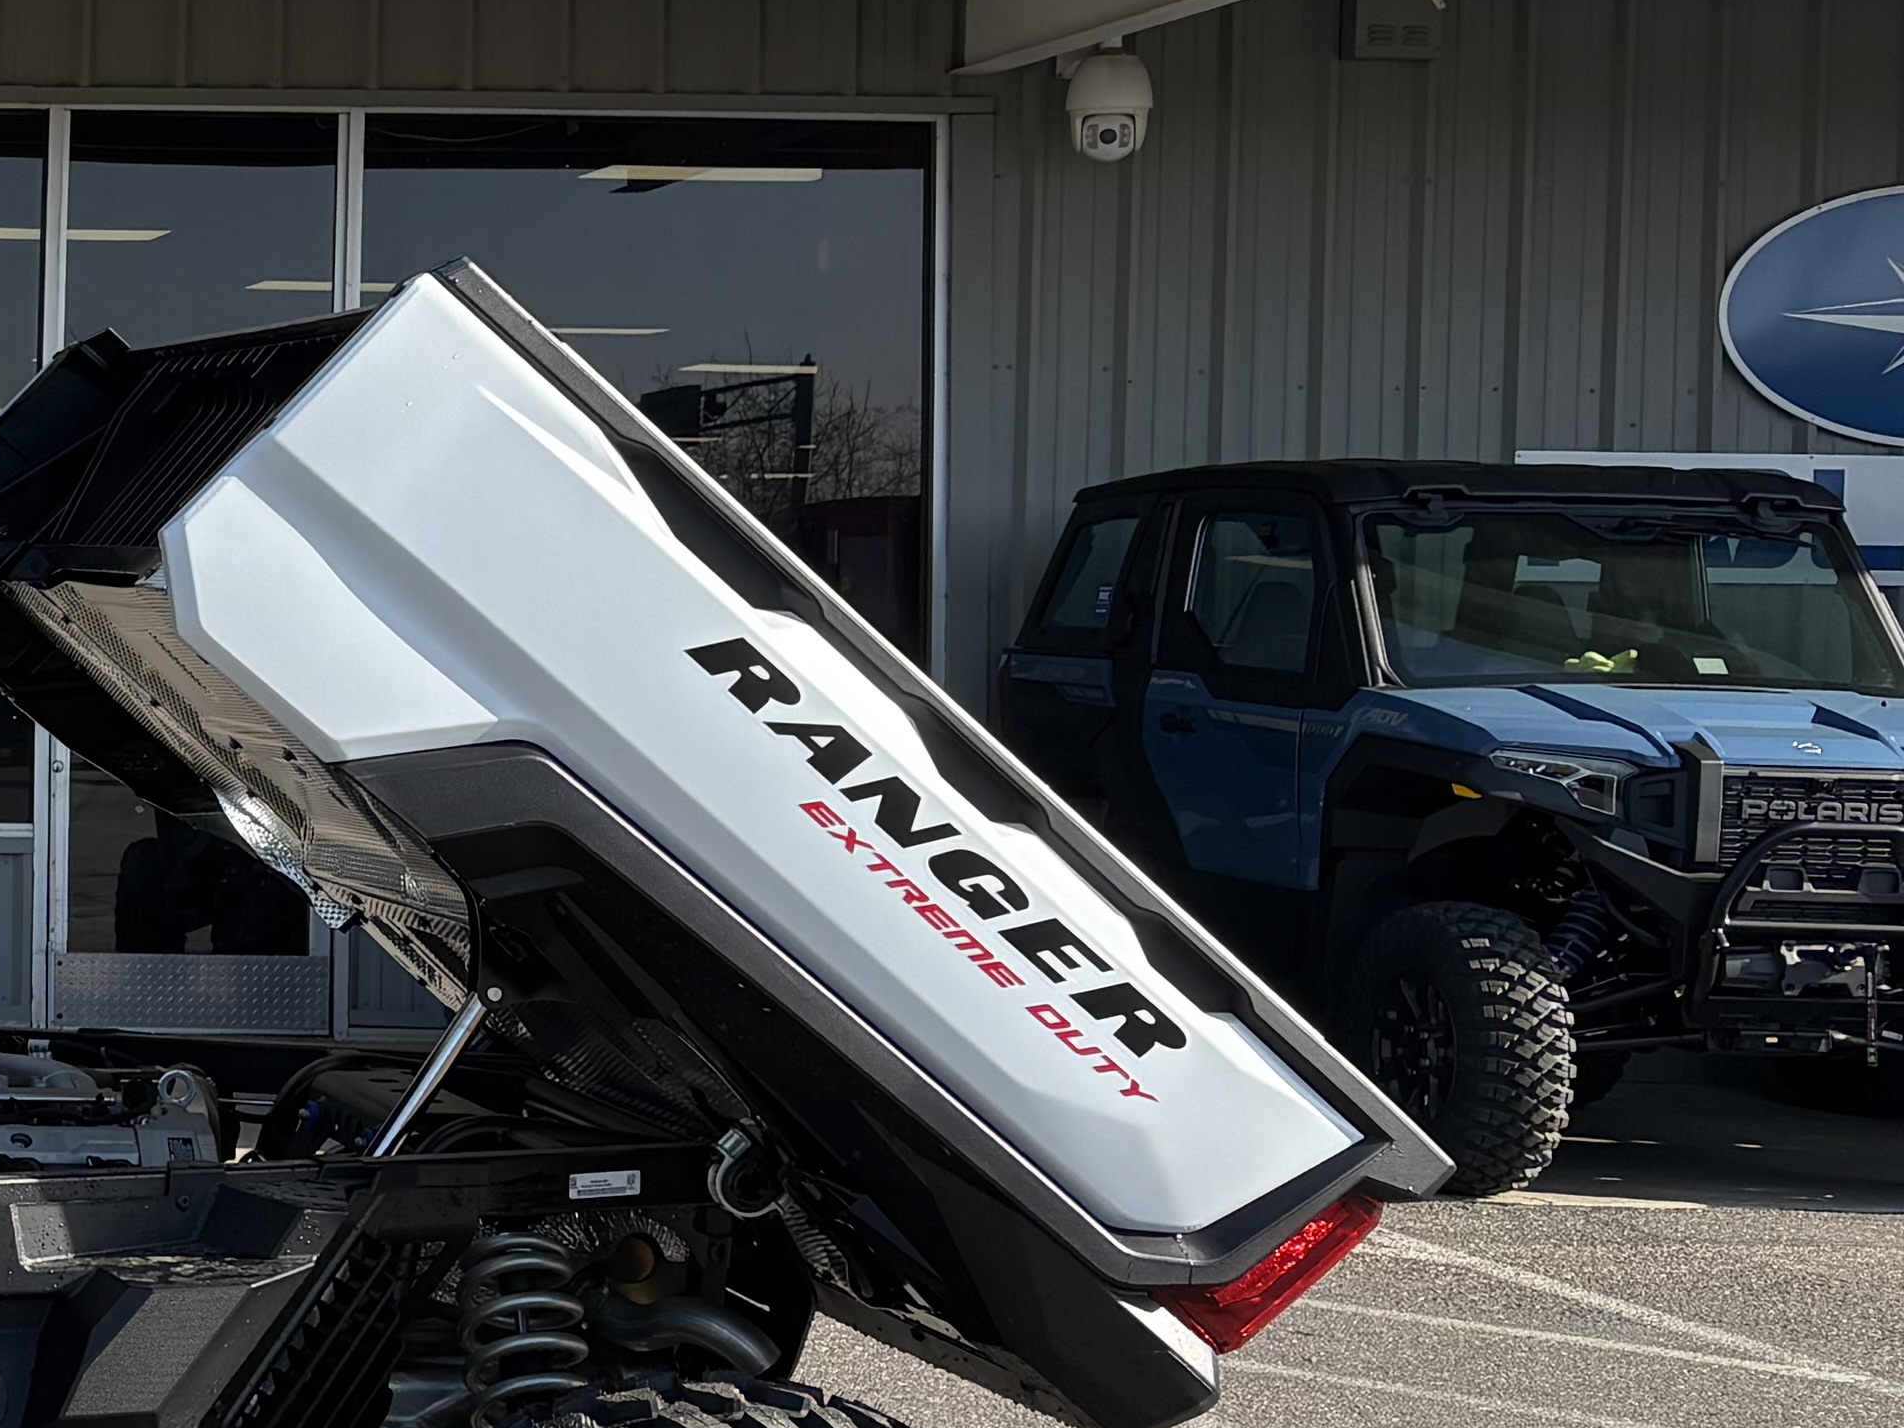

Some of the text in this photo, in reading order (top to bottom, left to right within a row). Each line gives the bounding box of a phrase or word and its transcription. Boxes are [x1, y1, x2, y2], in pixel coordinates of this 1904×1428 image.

[682, 637, 1188, 1059] RANGER
[798, 800, 1160, 1104] EXTREME DUTY
[1742, 799, 1904, 823] POLARIS
